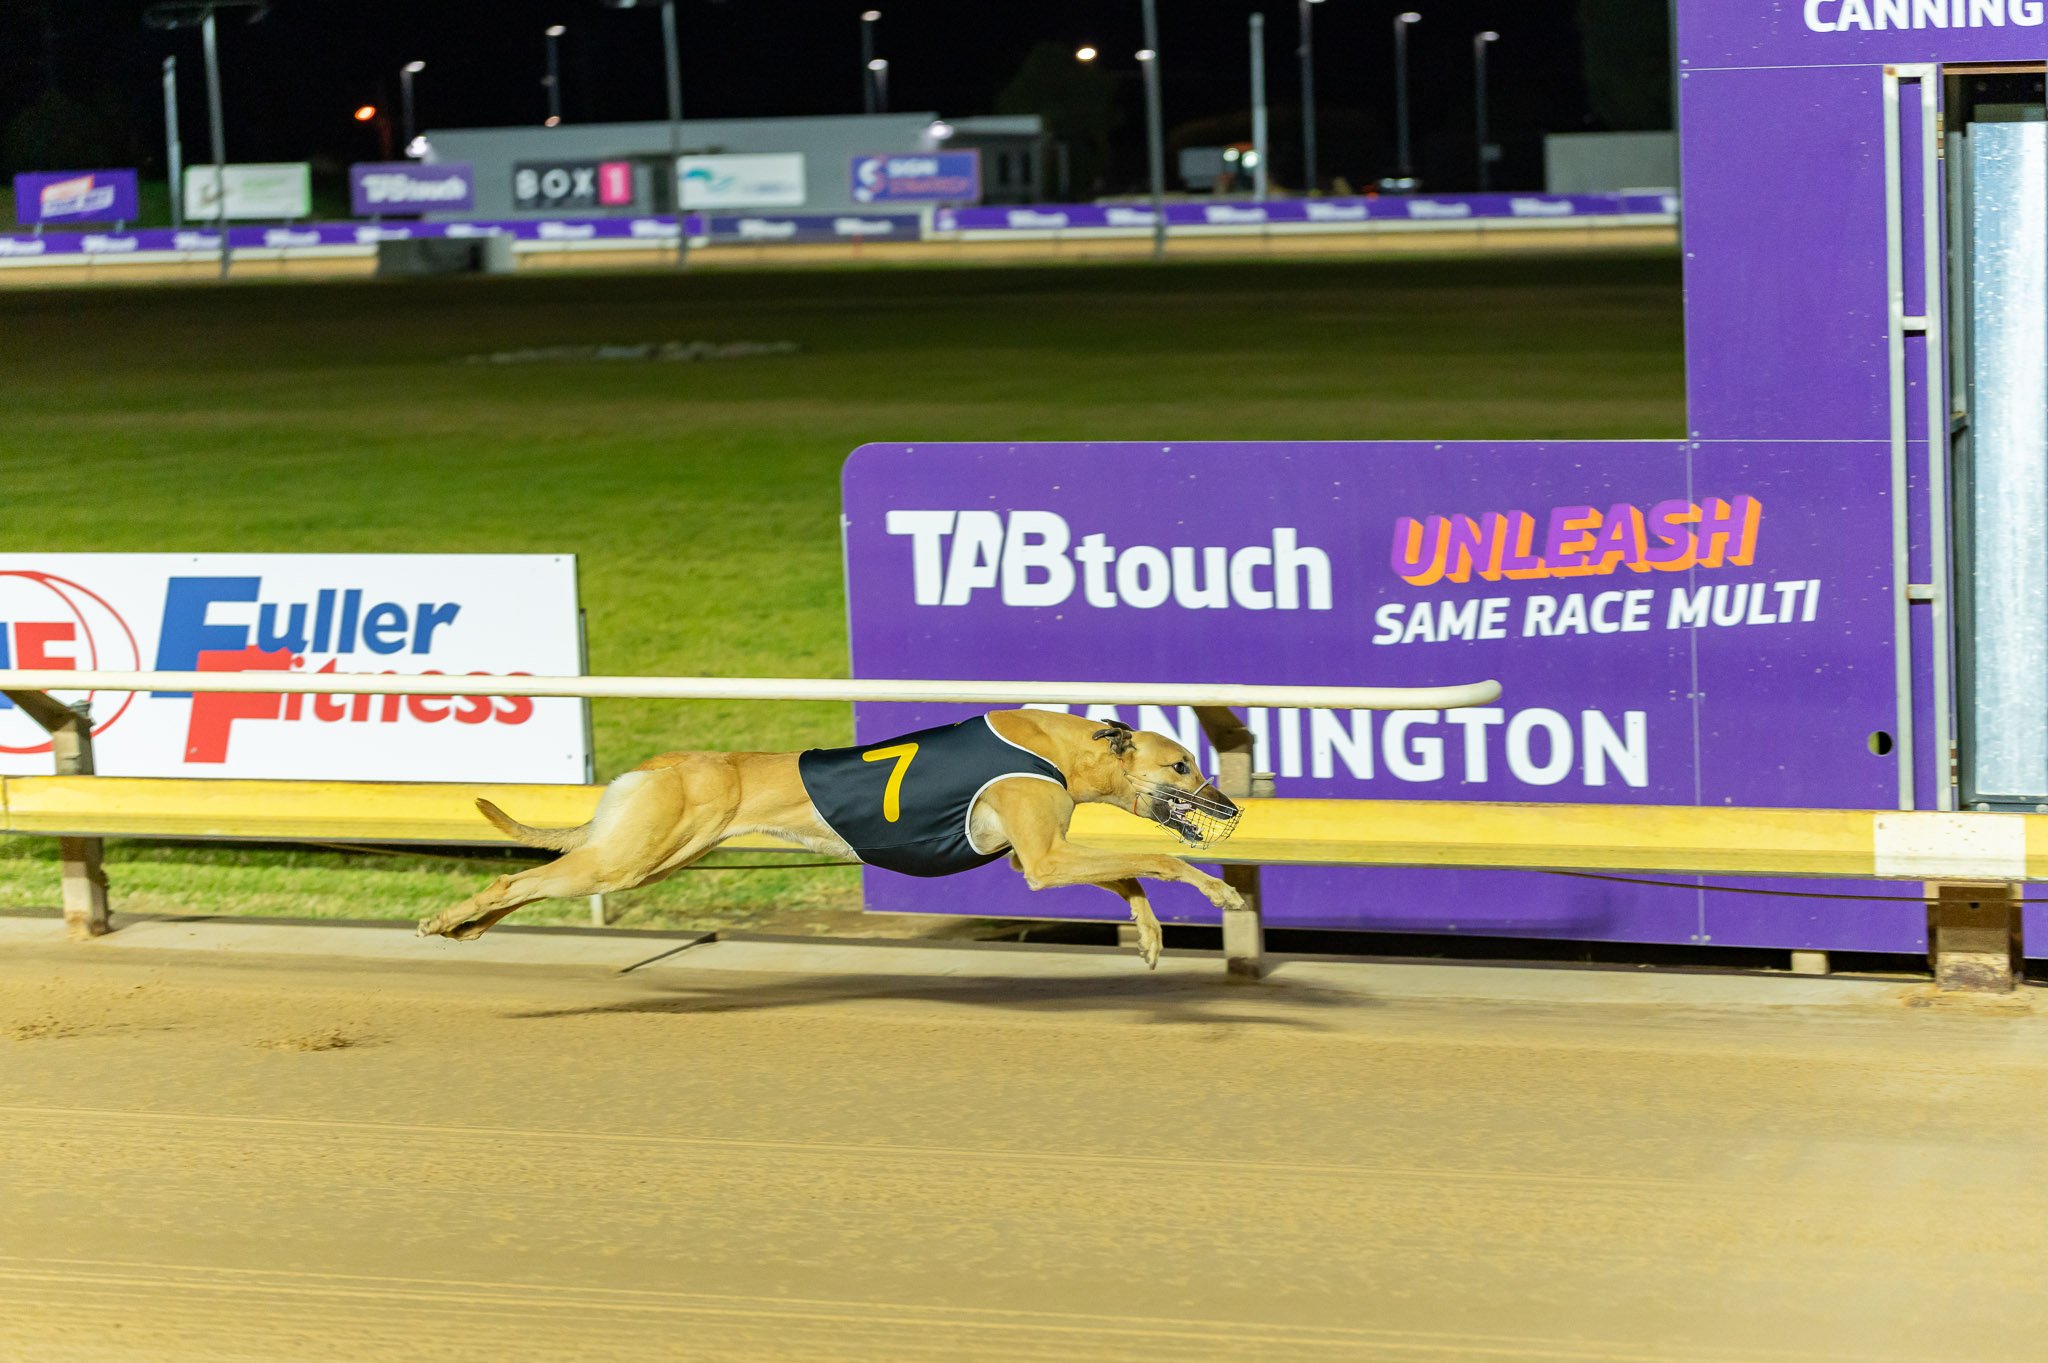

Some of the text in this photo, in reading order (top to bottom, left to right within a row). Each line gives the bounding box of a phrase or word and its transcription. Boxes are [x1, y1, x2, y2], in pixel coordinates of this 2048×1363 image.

[516, 167, 624, 200] BOX 1
[886, 510, 1333, 610] TABtouch
[1390, 494, 1762, 587] UNLEASH
[150, 576, 461, 698] Fuller
[1372, 579, 1821, 646] SAME RACE MULTI
[183, 644, 535, 764] Fitness
[862, 742, 919, 823] 7
